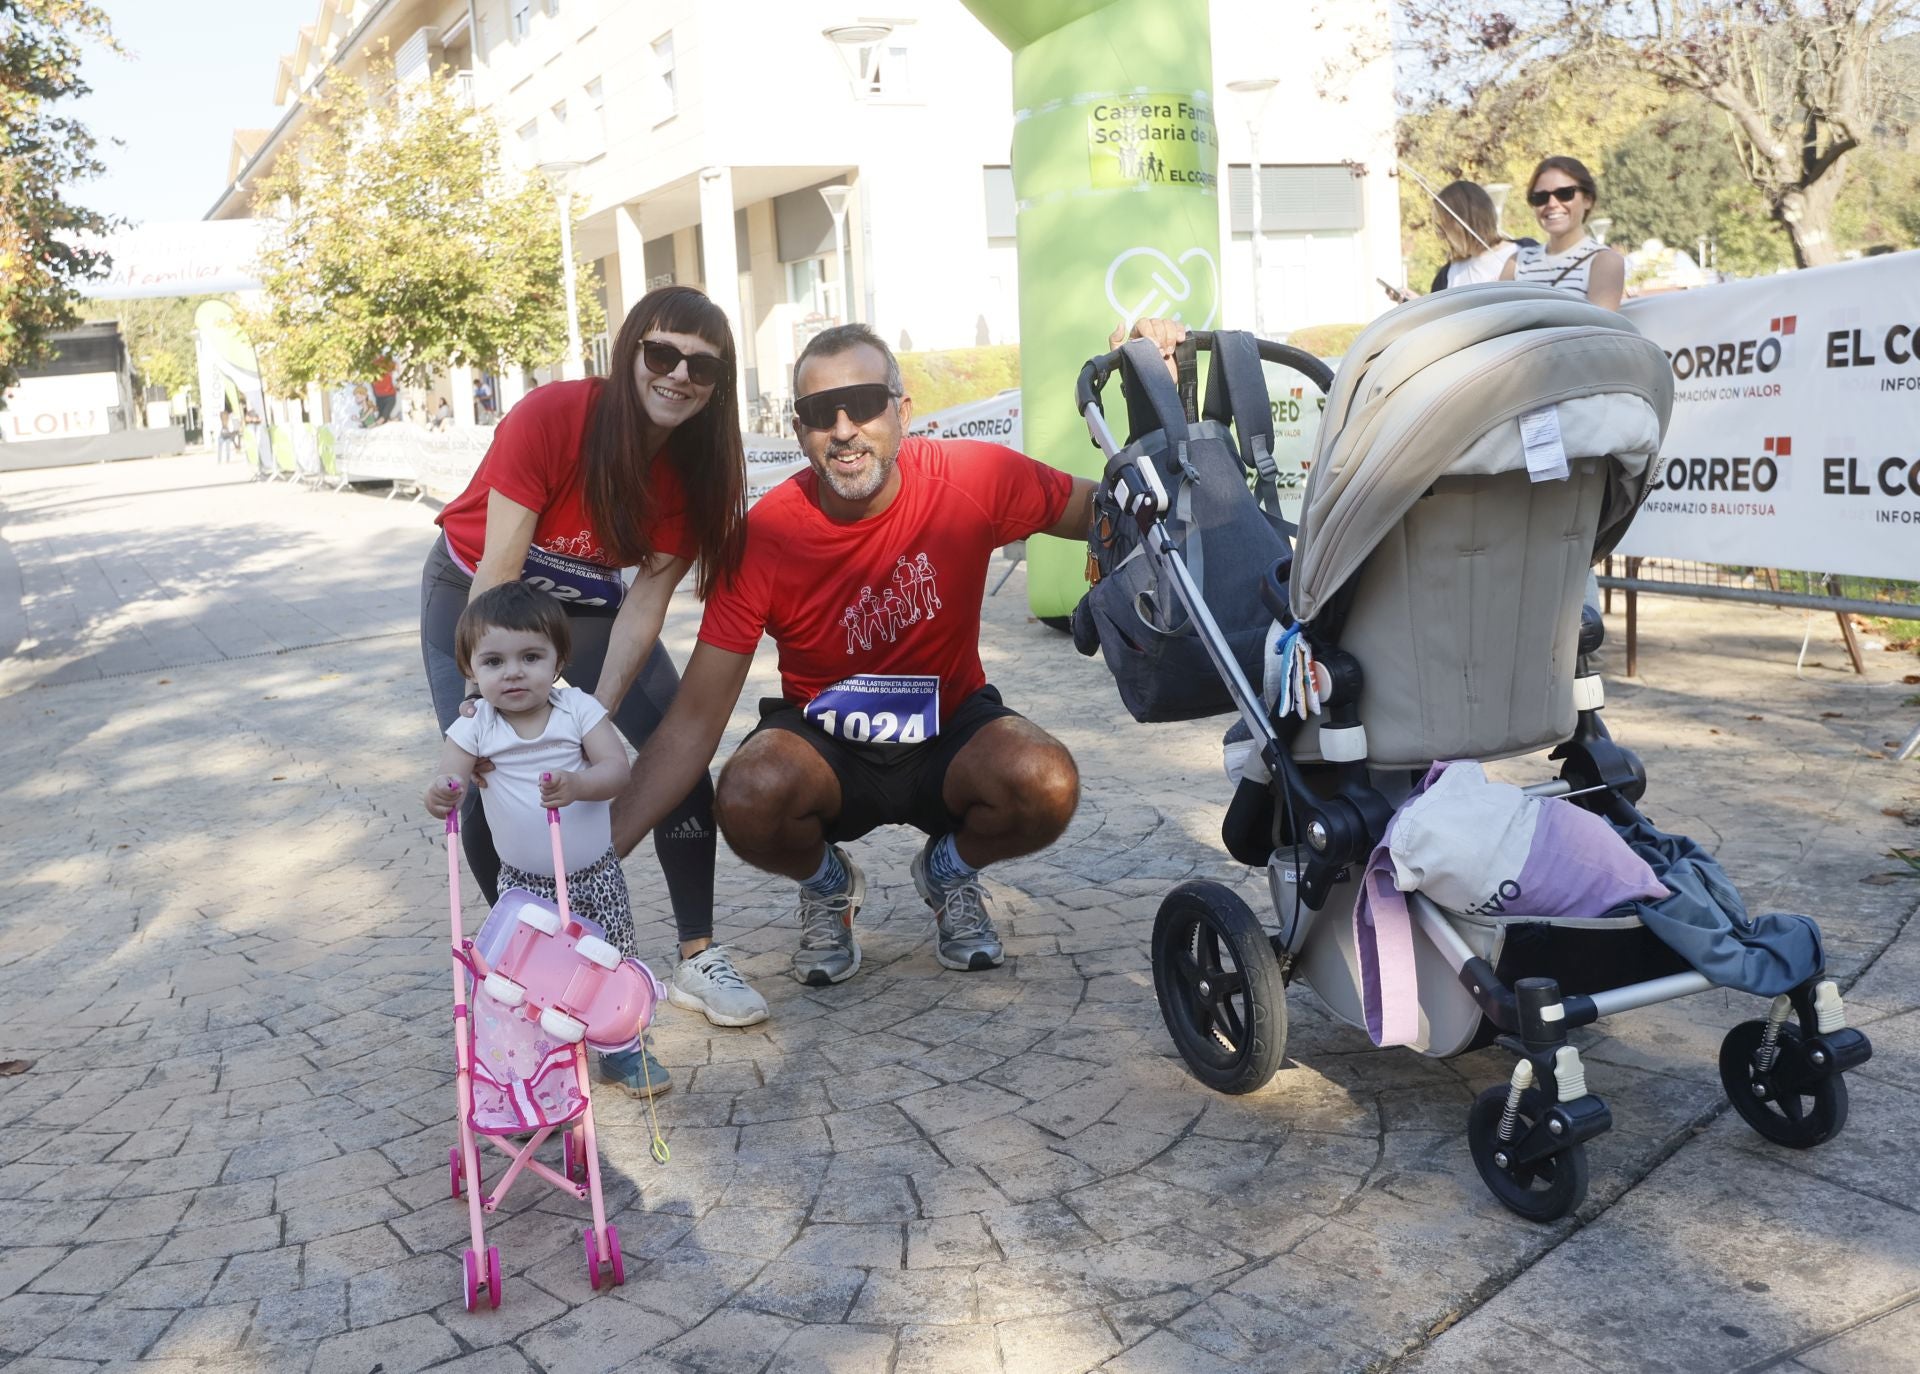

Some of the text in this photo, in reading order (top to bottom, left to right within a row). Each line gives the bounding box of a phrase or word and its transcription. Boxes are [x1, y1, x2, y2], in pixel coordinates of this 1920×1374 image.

[1094, 104, 1171, 121] Carrera
[1095, 124, 1185, 144] Solidaria
[1191, 126, 1206, 143] de
[1169, 169, 1186, 182] EL
[1826, 328, 1875, 369] EL
[1664, 337, 1782, 381] ORREO
[1673, 384, 1782, 403] RMACIÓN CON VALOR
[959, 418, 1013, 438] CORREO
[747, 451, 760, 463] EL
[1823, 457, 1871, 496] EL
[1643, 502, 1776, 516] INFORMAZIO BALIOTSUA
[1876, 509, 1920, 524] INFOR
[843, 679, 866, 687] FAMILIA
[867, 680, 902, 688] LASTERKETA
[850, 685, 880, 694] FAMILIAR
[817, 709, 928, 744] 1024
